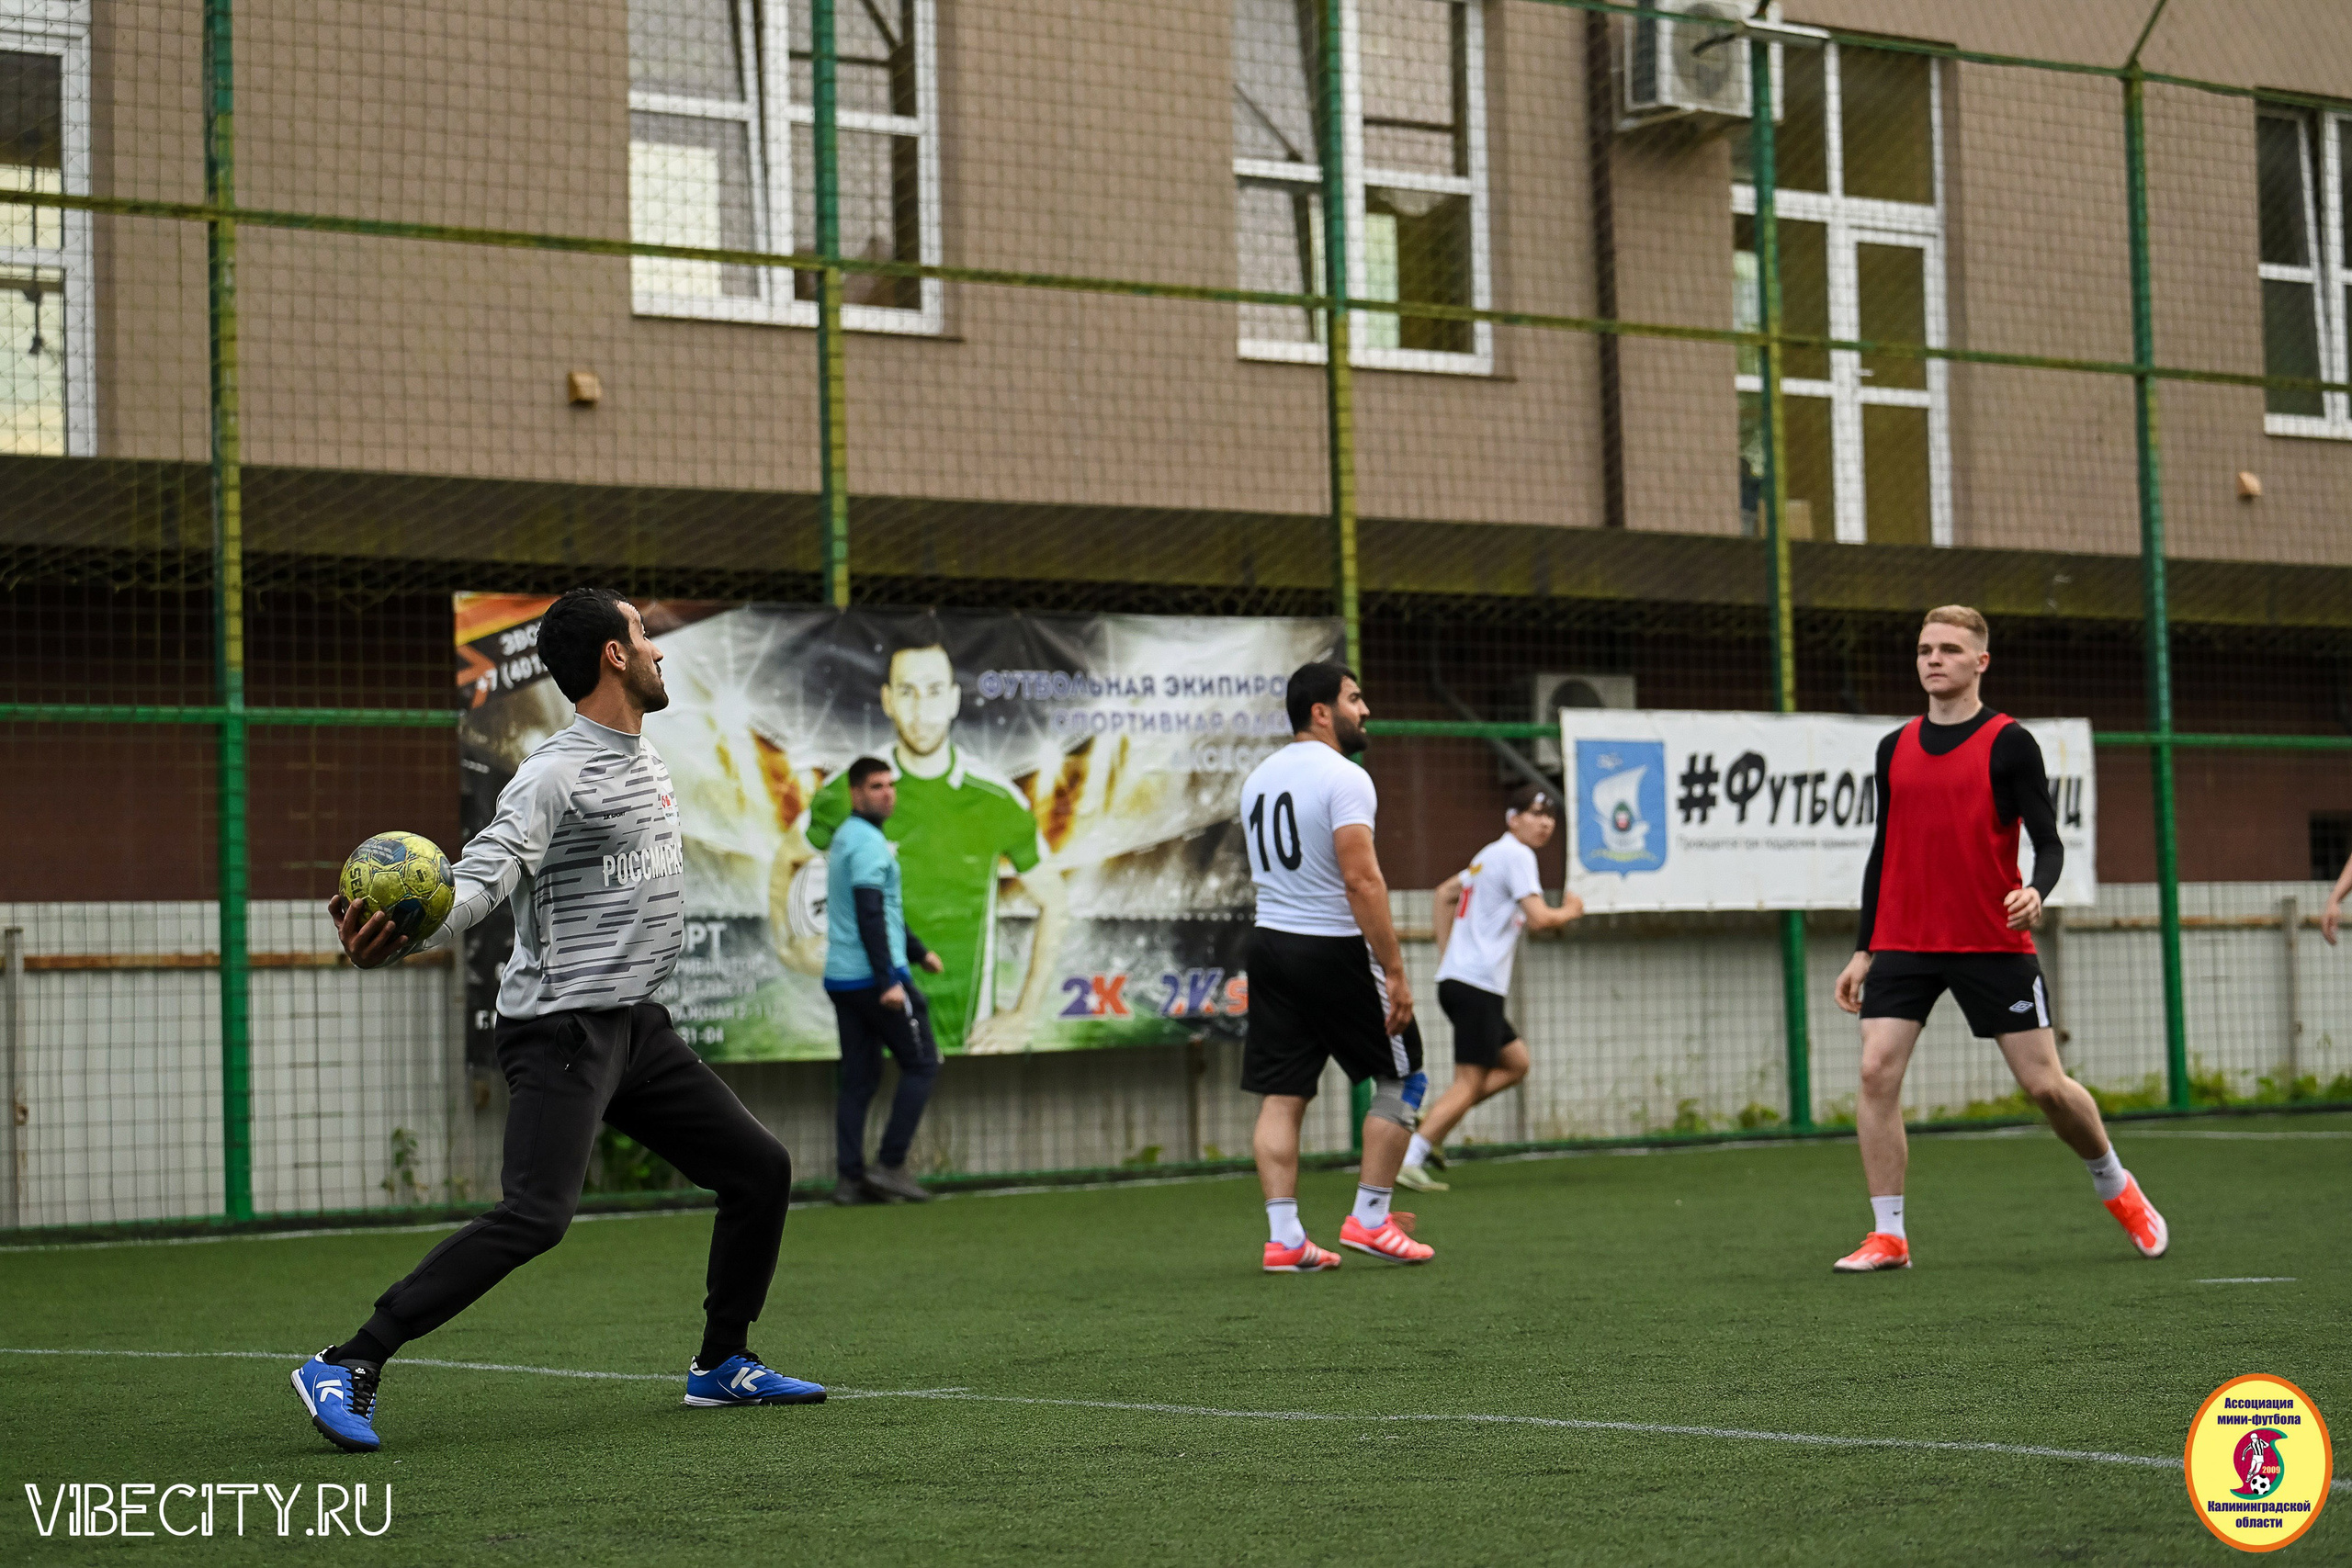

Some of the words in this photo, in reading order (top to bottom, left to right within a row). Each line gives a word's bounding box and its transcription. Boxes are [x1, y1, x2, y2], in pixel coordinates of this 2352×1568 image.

[977, 670, 1156, 700] ФУТБОЛЬНАЯ
[1166, 674, 1288, 698] ЭКИПИРО
[1250, 792, 1302, 872] 10
[603, 842, 683, 886] РОССМАРК
